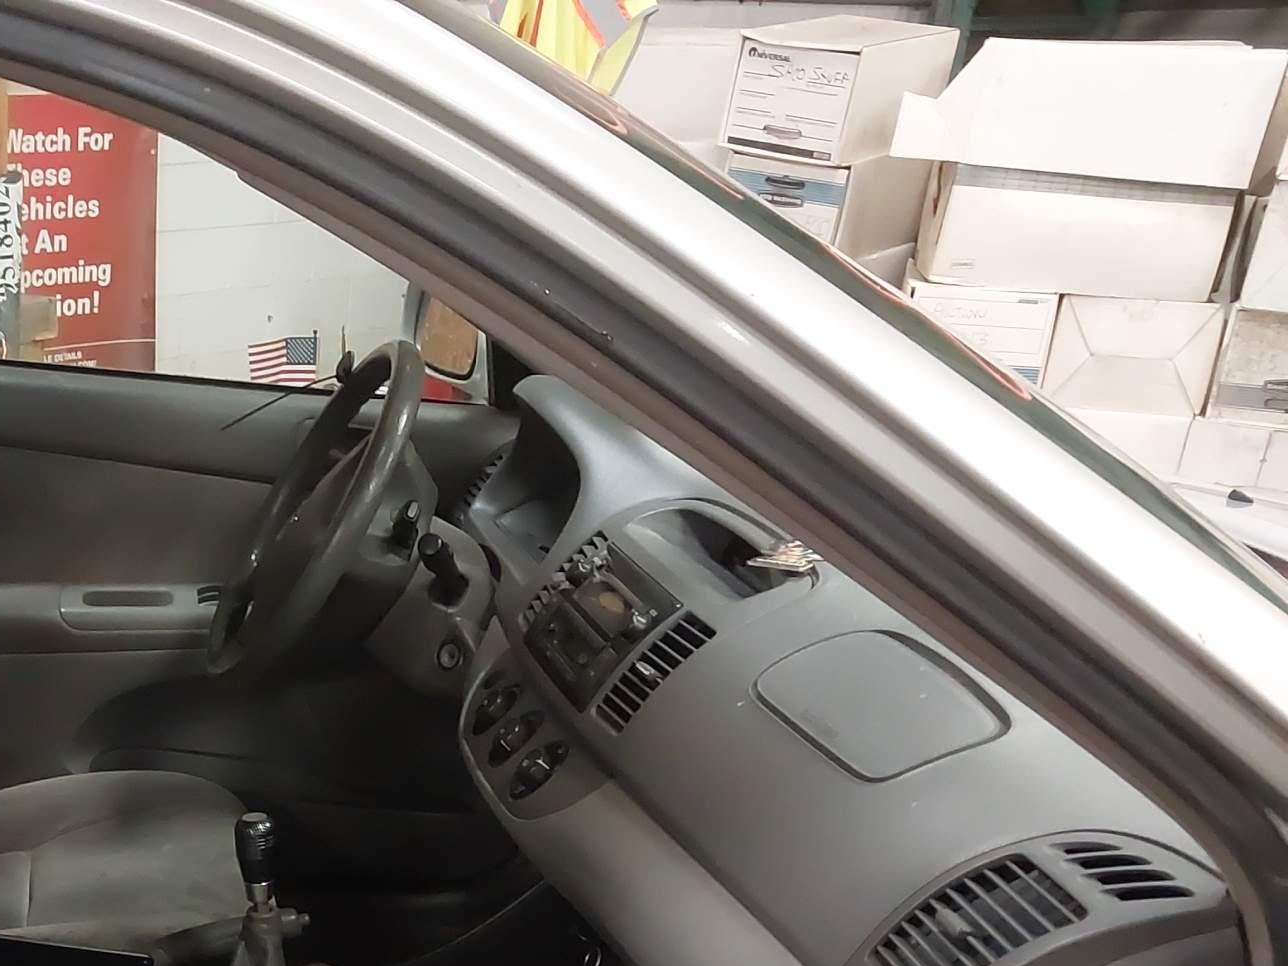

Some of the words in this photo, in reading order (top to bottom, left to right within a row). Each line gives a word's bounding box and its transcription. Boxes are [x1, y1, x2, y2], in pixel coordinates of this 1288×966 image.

[77, 126, 114, 152] For
[7, 162, 72, 188] hese
[20, 193, 100, 222] ehicles
[34, 228, 68, 254] An
[20, 259, 112, 294] pcoming
[55, 290, 100, 318] ion!
